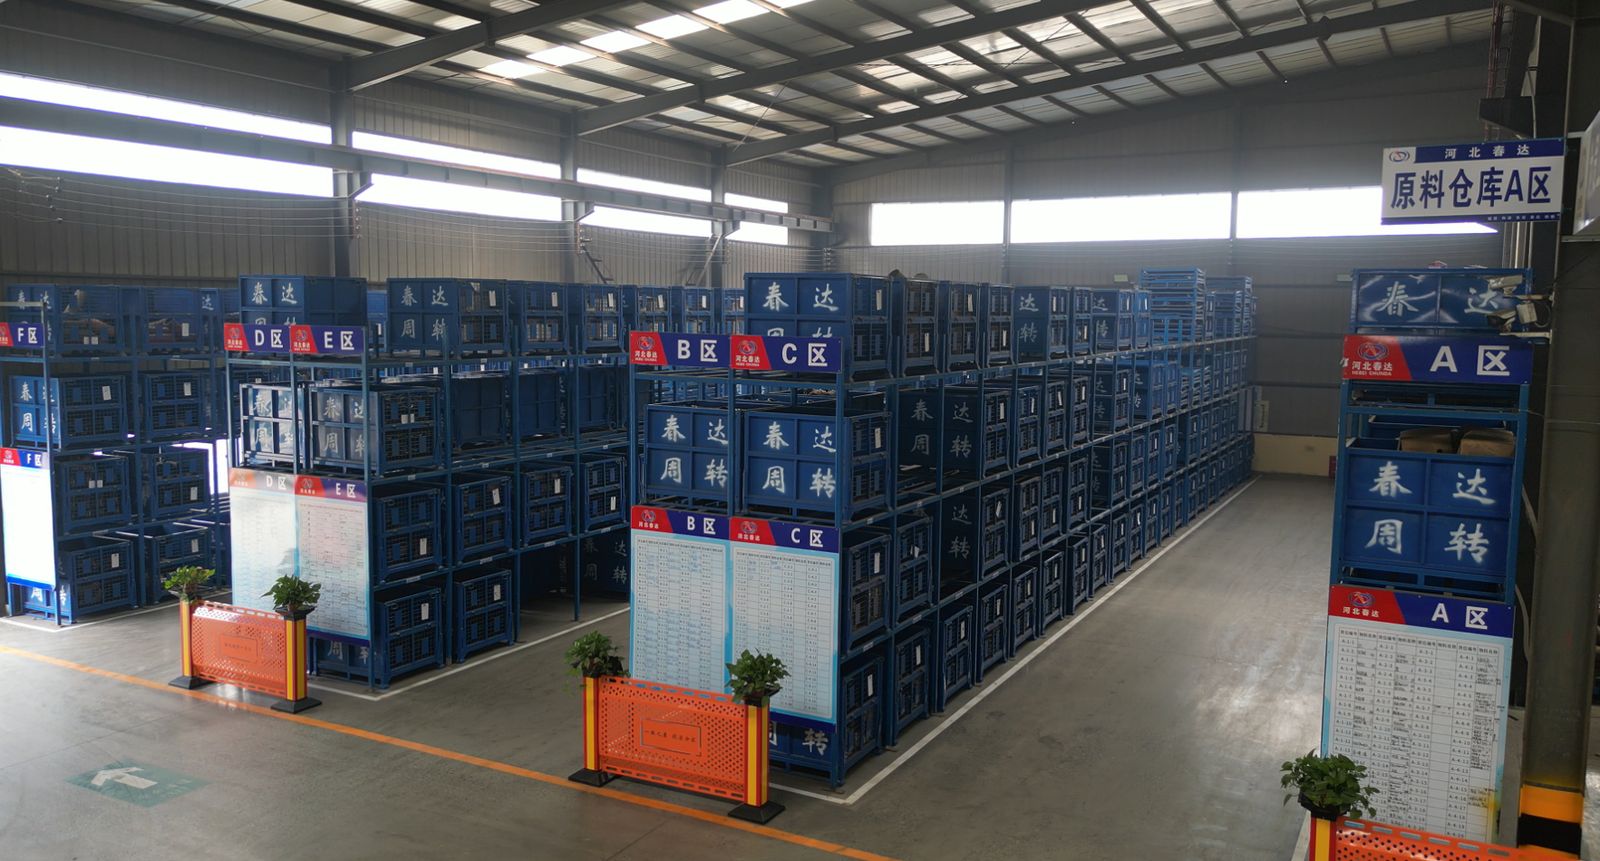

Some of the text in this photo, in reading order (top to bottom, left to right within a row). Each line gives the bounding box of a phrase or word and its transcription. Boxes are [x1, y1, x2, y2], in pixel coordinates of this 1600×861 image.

[1445, 144, 1530, 159] 河北春达
[1390, 166, 1551, 210] 原料仓库A区
[252, 281, 298, 305] 春达
[401, 285, 448, 307] 春达
[762, 281, 839, 312] 春达
[1018, 293, 1039, 312] 达
[18, 327, 38, 344] F区
[255, 329, 283, 348] D区
[324, 331, 355, 350] E区
[677, 339, 719, 362] B区
[781, 343, 828, 367] C区
[1429, 345, 1510, 376] A区
[1351, 361, 1393, 371] 河北春达
[661, 414, 729, 445] 春达
[763, 421, 837, 453] 春达
[266, 475, 287, 491] D区
[660, 457, 729, 488] 周转
[762, 465, 837, 498] 周转
[1368, 460, 1496, 504] 春达
[335, 483, 356, 498] E区
[687, 516, 716, 535] B区
[791, 527, 824, 548] C区
[1364, 518, 1490, 564] 周转
[1342, 606, 1380, 618] 河北春达
[1431, 603, 1489, 630] A区
